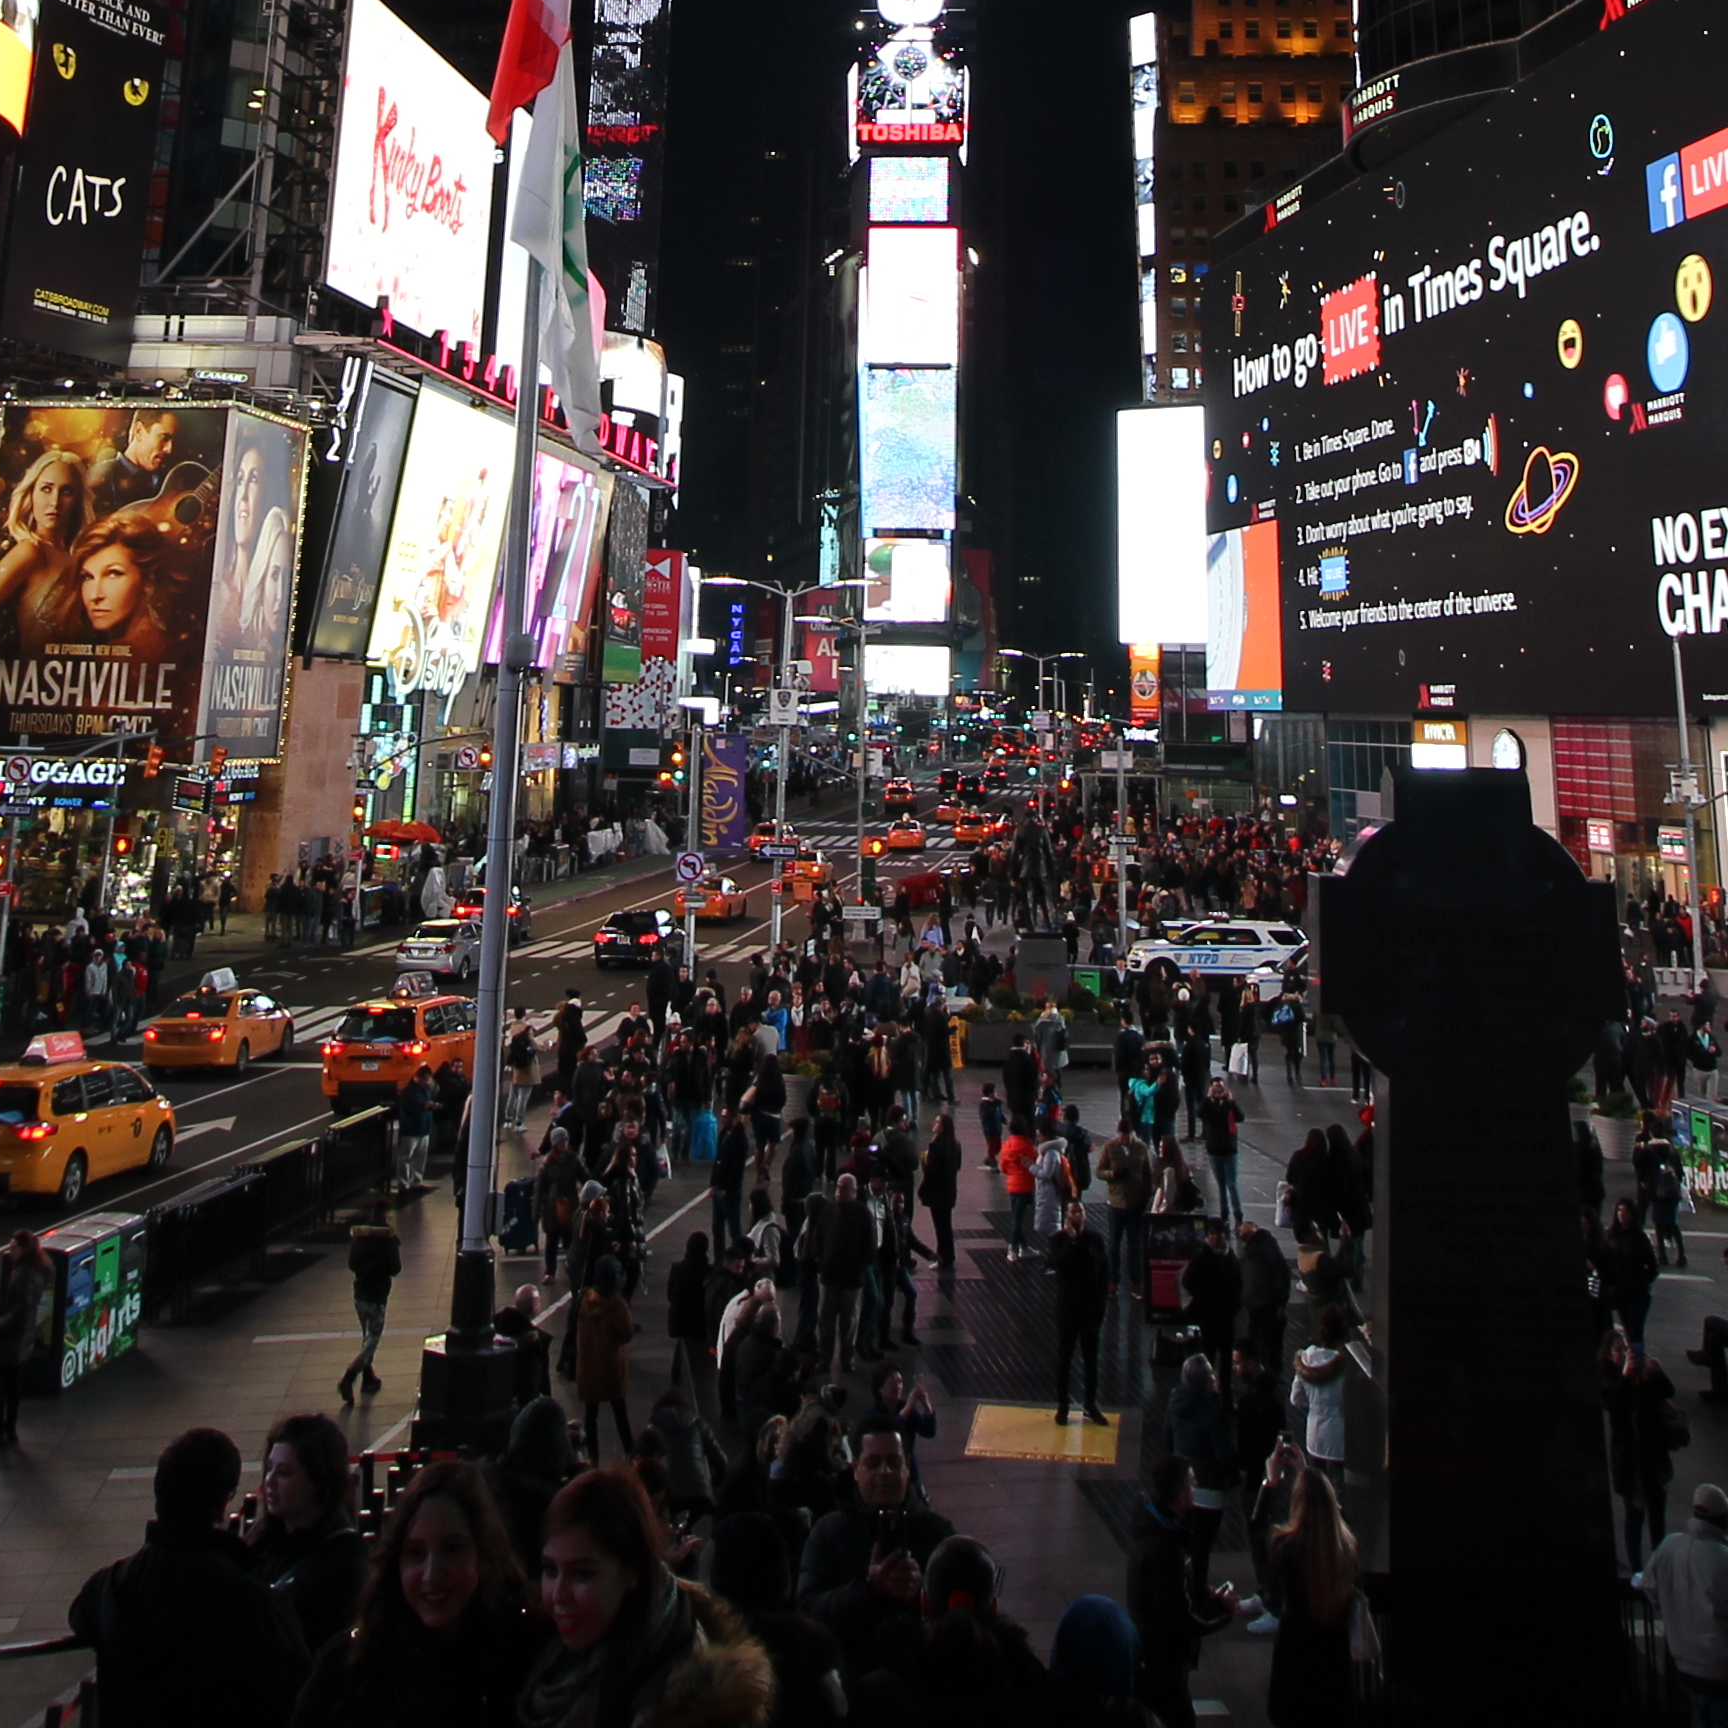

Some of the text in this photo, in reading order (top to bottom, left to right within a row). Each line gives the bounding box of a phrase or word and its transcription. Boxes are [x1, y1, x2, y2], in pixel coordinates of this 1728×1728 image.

[98, 5, 130, 33] THAN
[126, 2, 151, 24] AND
[1352, 73, 1400, 107] MARRIOTT
[1352, 95, 1394, 127] MARQUIS
[858, 124, 962, 142] TOSHIBA
[46, 165, 127, 226] CATS
[1233, 210, 1601, 398] How to go LIVE in Times Square.
[1646, 391, 1686, 413] MARRIOTT
[1647, 407, 1683, 425] MARQUIS
[1321, 431, 1343, 456] Times
[1378, 464, 1392, 482] Go
[1392, 462, 1402, 479] to
[1419, 452, 1438, 473] and
[1438, 445, 1462, 474] press
[1369, 510, 1390, 531] what
[1418, 498, 1443, 530] going
[1443, 499, 1455, 517] to
[1651, 508, 1702, 567] NO
[1306, 566, 1319, 586] Hit
[1387, 604, 1397, 621] to
[1397, 601, 1414, 621] the
[1414, 600, 1442, 619] center
[1443, 593, 1454, 617] of
[1454, 592, 1473, 616] the
[1473, 589, 1518, 614] universe.
[209, 663, 281, 711] NASHVILLE
[9, 712, 152, 736] THURSDAYS 9PM CMT
[1187, 951, 1220, 966] NYPD
